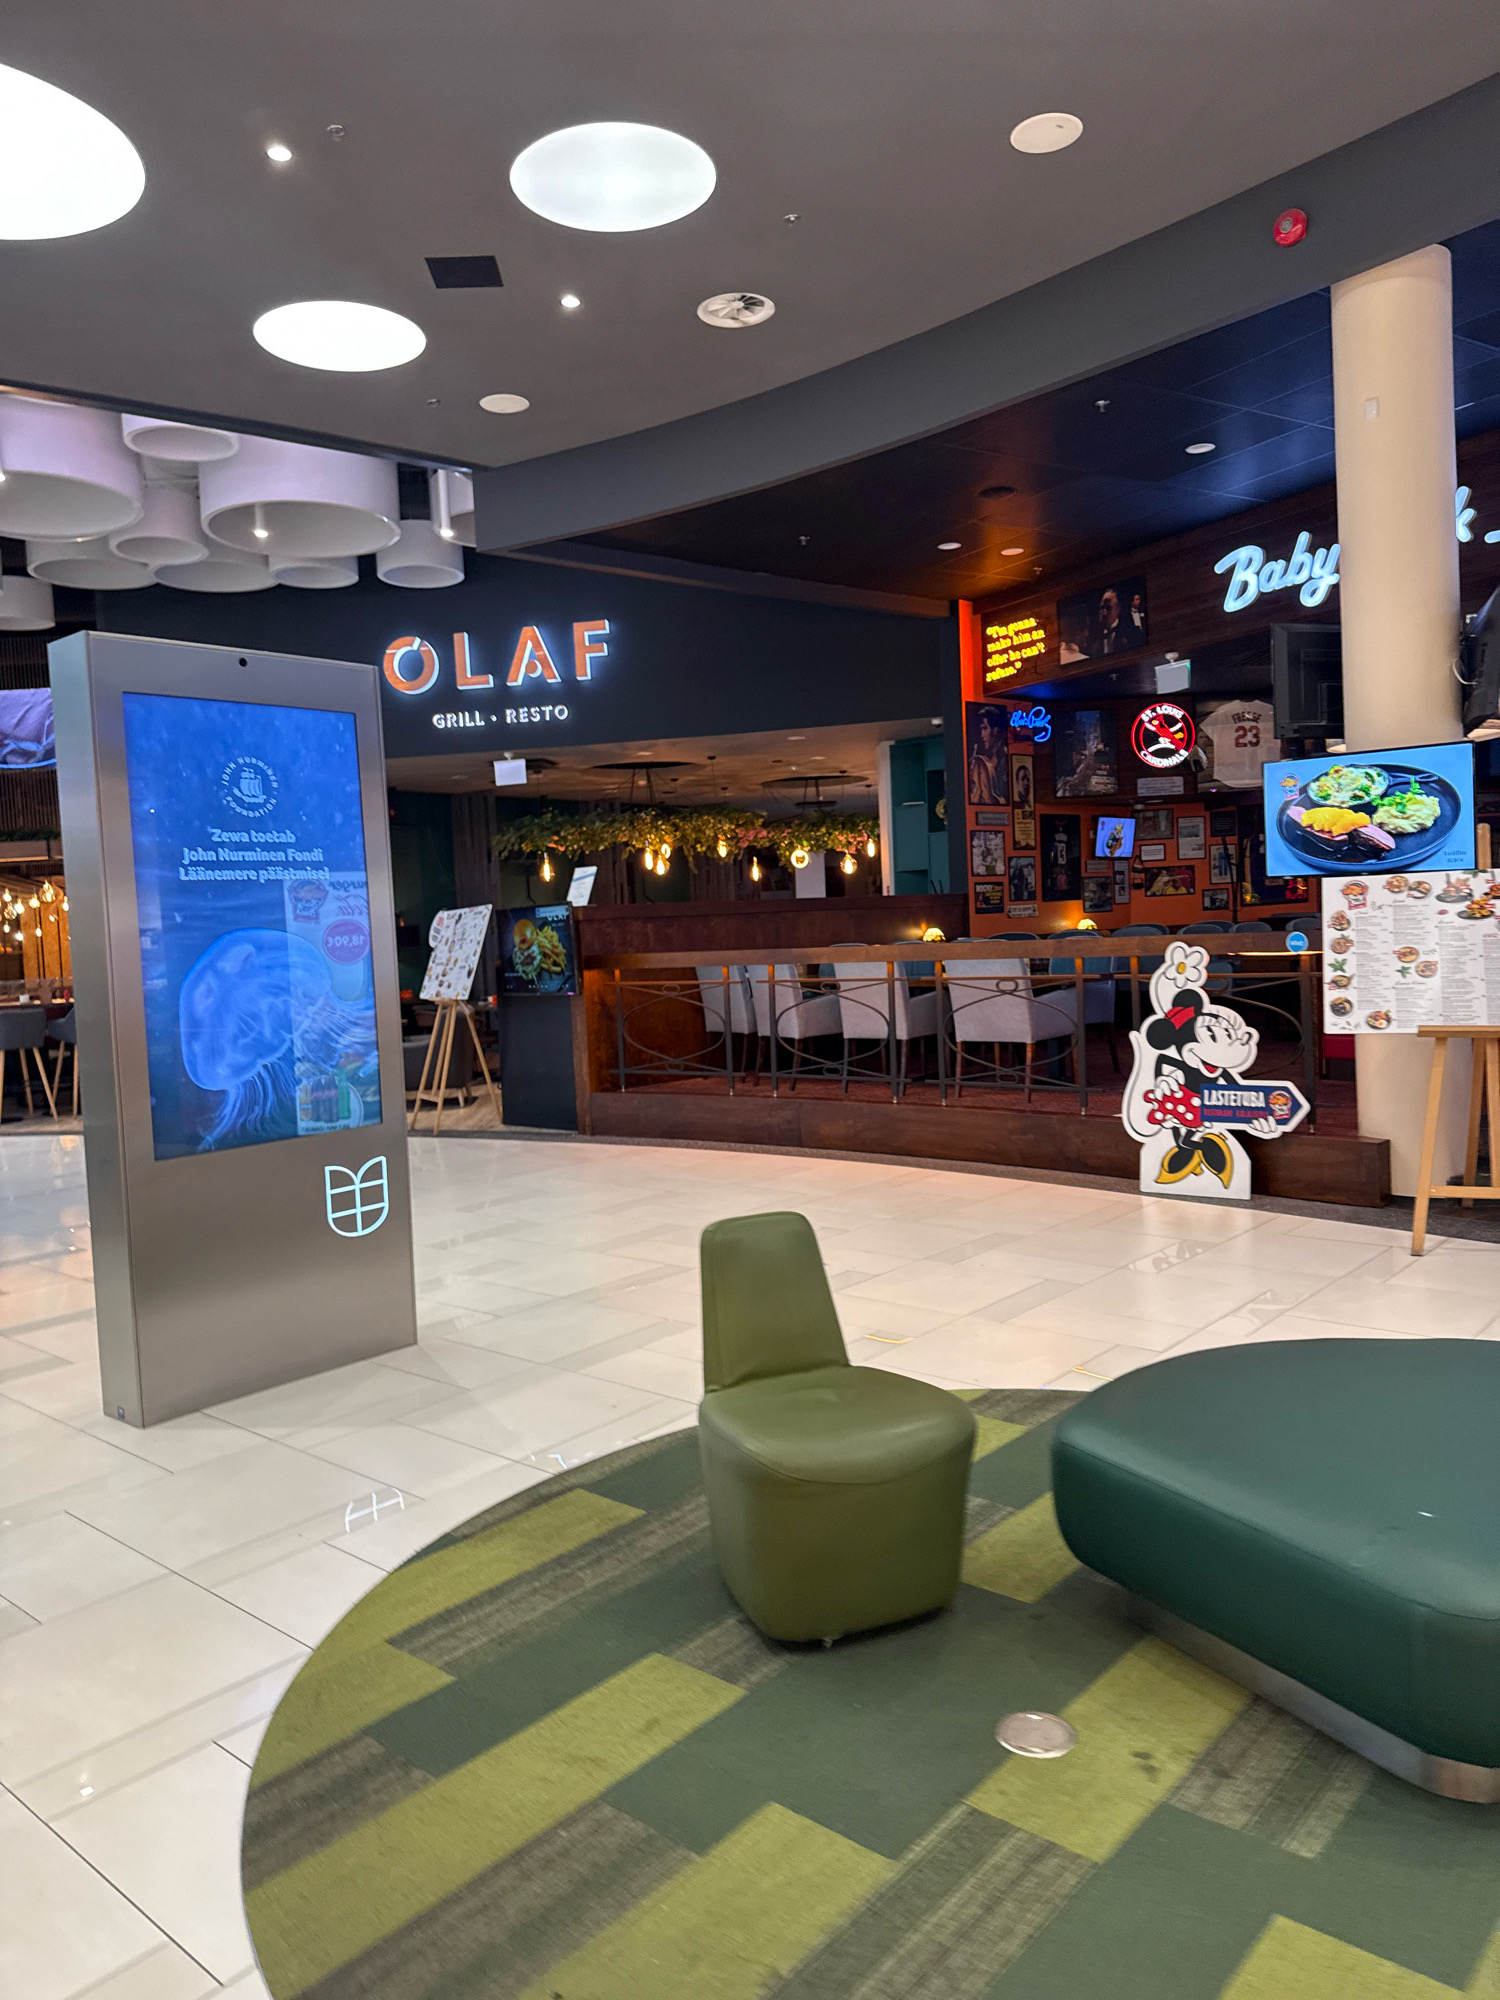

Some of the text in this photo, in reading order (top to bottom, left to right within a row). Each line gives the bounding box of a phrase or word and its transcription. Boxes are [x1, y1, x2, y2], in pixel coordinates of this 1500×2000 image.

[1214, 531, 1341, 613] Baby
[383, 619, 610, 695] OLAF
[432, 705, 569, 729] GRILL RESTO
[1141, 704, 1184, 722] ST. LOUIS
[1234, 725, 1261, 748] 23
[1140, 749, 1189, 768] CARDINALS
[221, 762, 237, 786] JOHN
[223, 796, 277, 818] FOUNDATION
[210, 828, 296, 843] Zewa toetab
[182, 847, 324, 865] John Nurminen Fondi
[179, 866, 330, 883] Läänemere päästmisel
